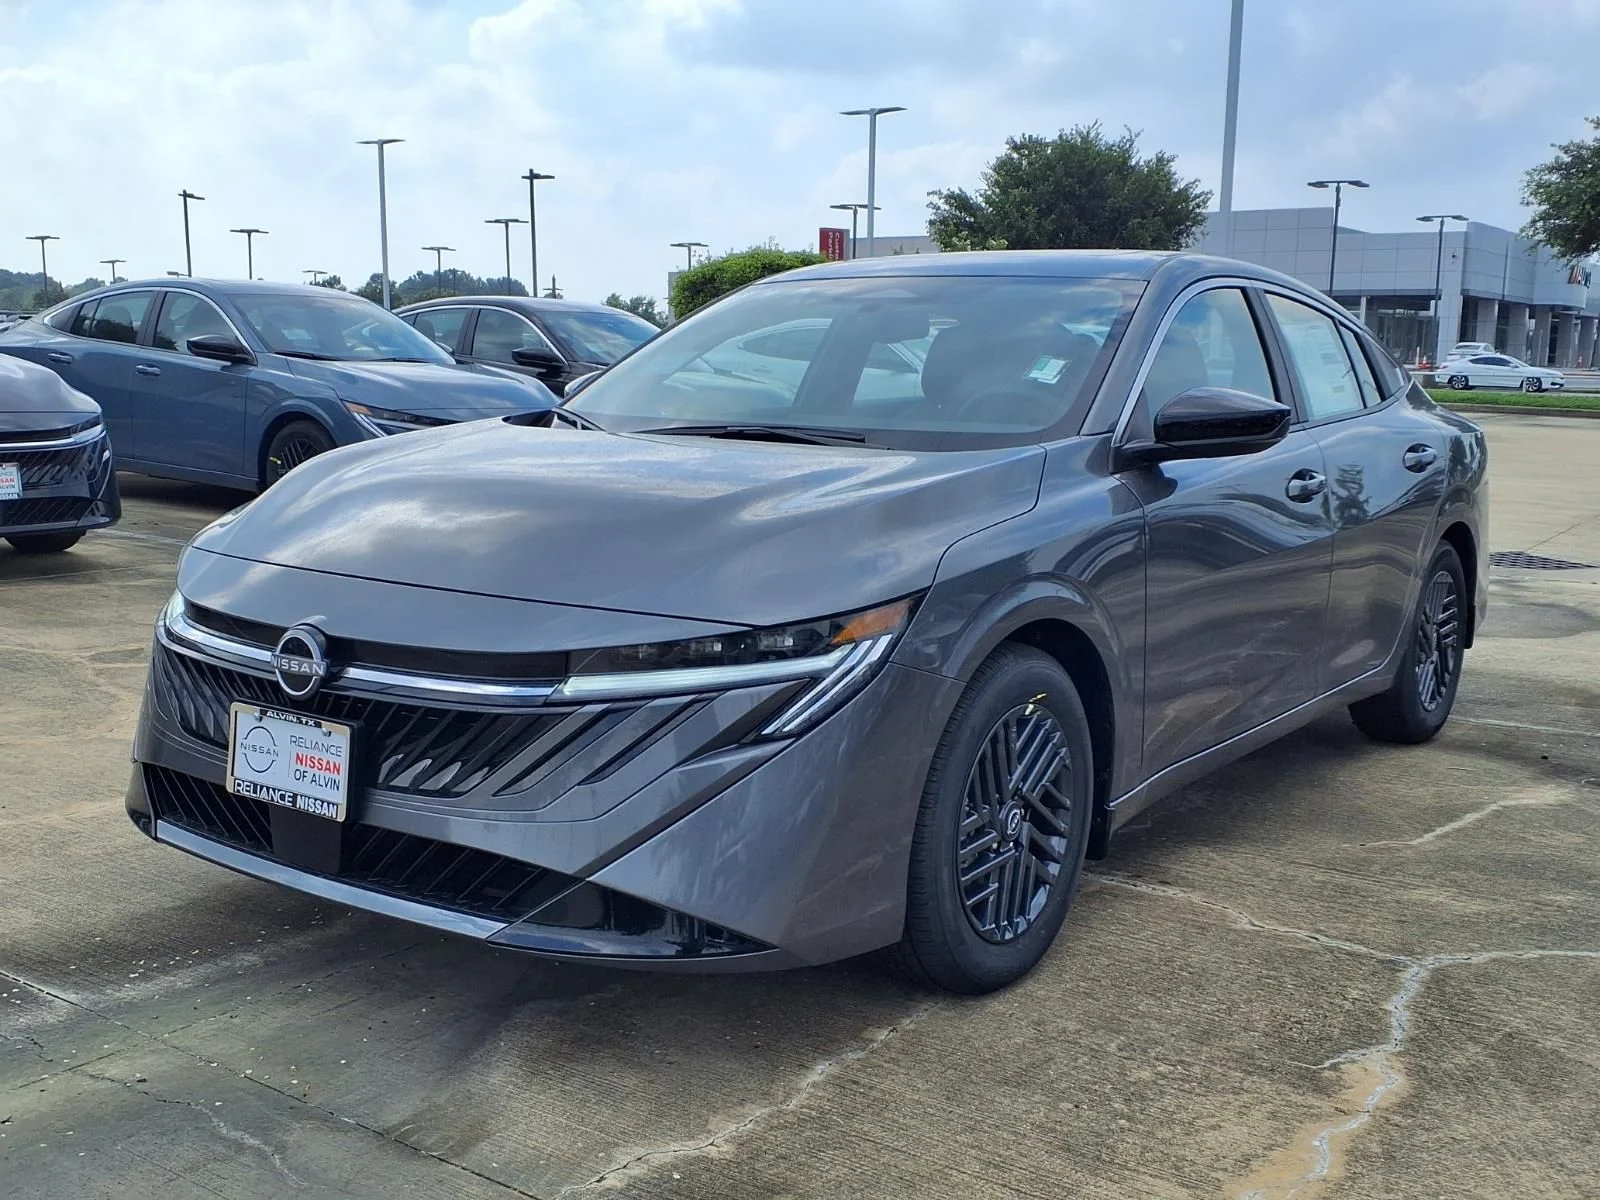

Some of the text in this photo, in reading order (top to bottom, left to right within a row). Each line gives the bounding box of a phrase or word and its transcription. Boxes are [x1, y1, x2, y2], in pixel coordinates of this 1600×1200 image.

[271, 656, 324, 675] NISSAN
[301, 718, 316, 726] TX
[240, 742, 279, 757] NISSAN
[290, 735, 342, 757] RELIANCE
[295, 752, 341, 776] NISSAN
[294, 768, 340, 791] OF ALVIN
[234, 779, 339, 818] RELIANCE NISSAN
